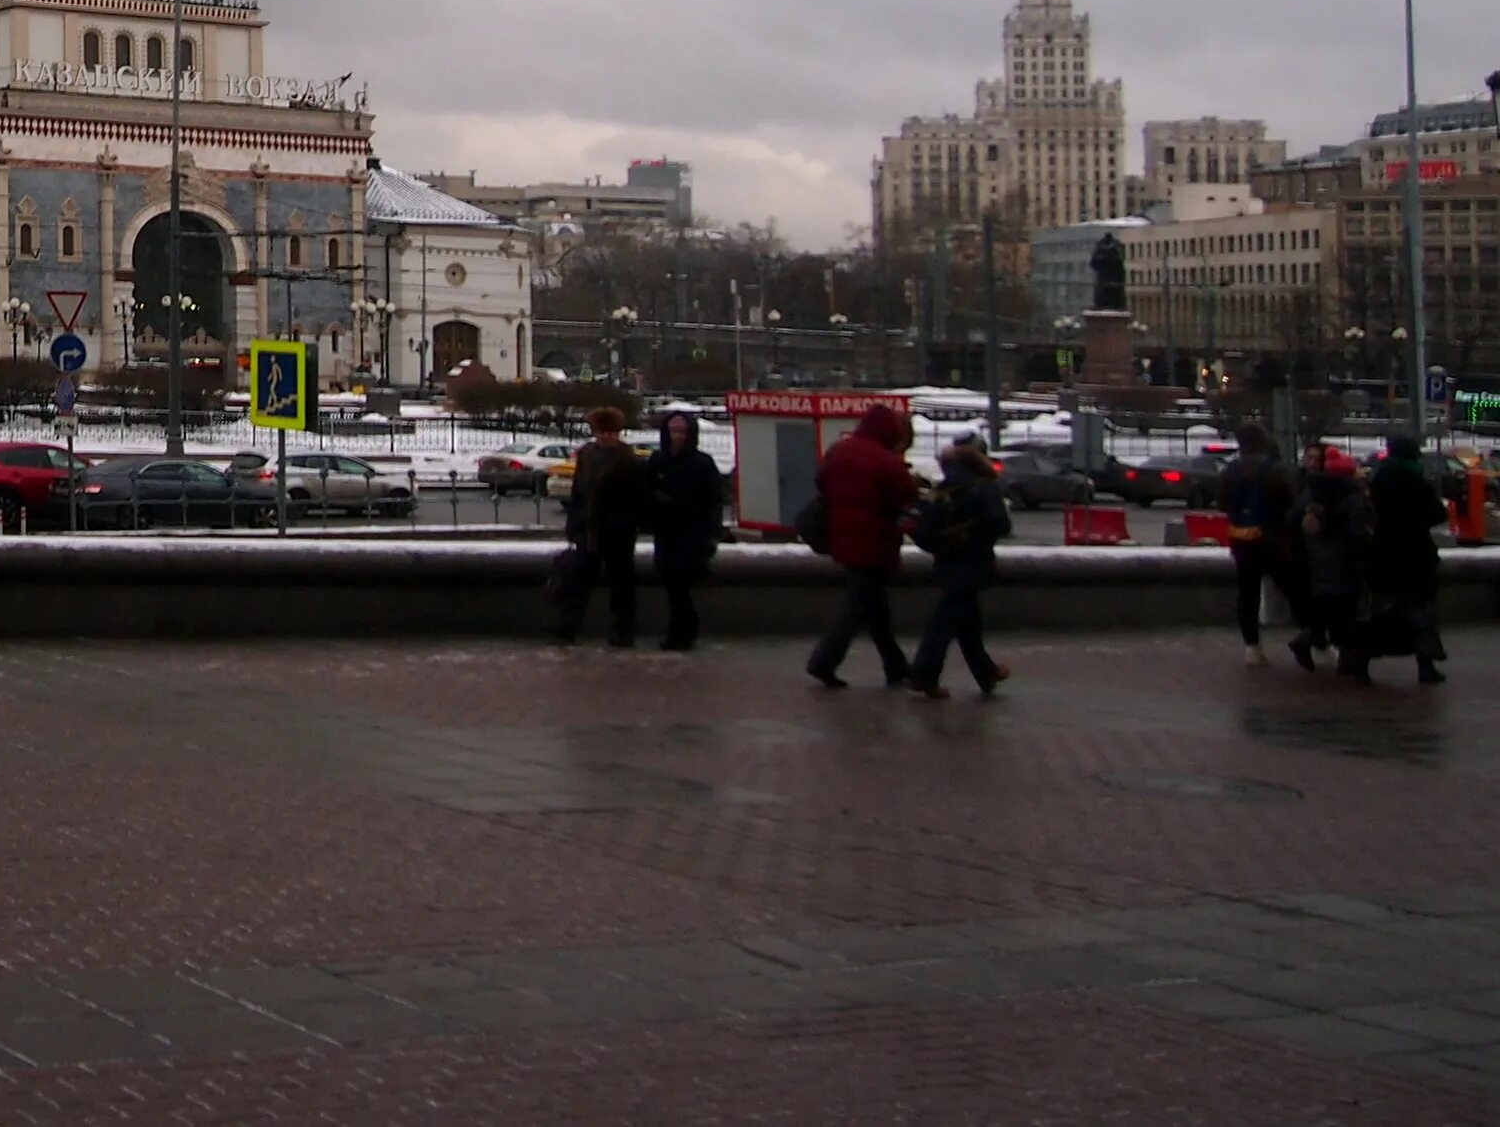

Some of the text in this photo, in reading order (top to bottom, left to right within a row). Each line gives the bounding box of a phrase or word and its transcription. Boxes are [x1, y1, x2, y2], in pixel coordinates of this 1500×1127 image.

[12, 57, 341, 105] КАЗАНСКИЙ ВОКЗАЛ
[729, 393, 904, 413] ПАРКОВКА ПАРКОКА
